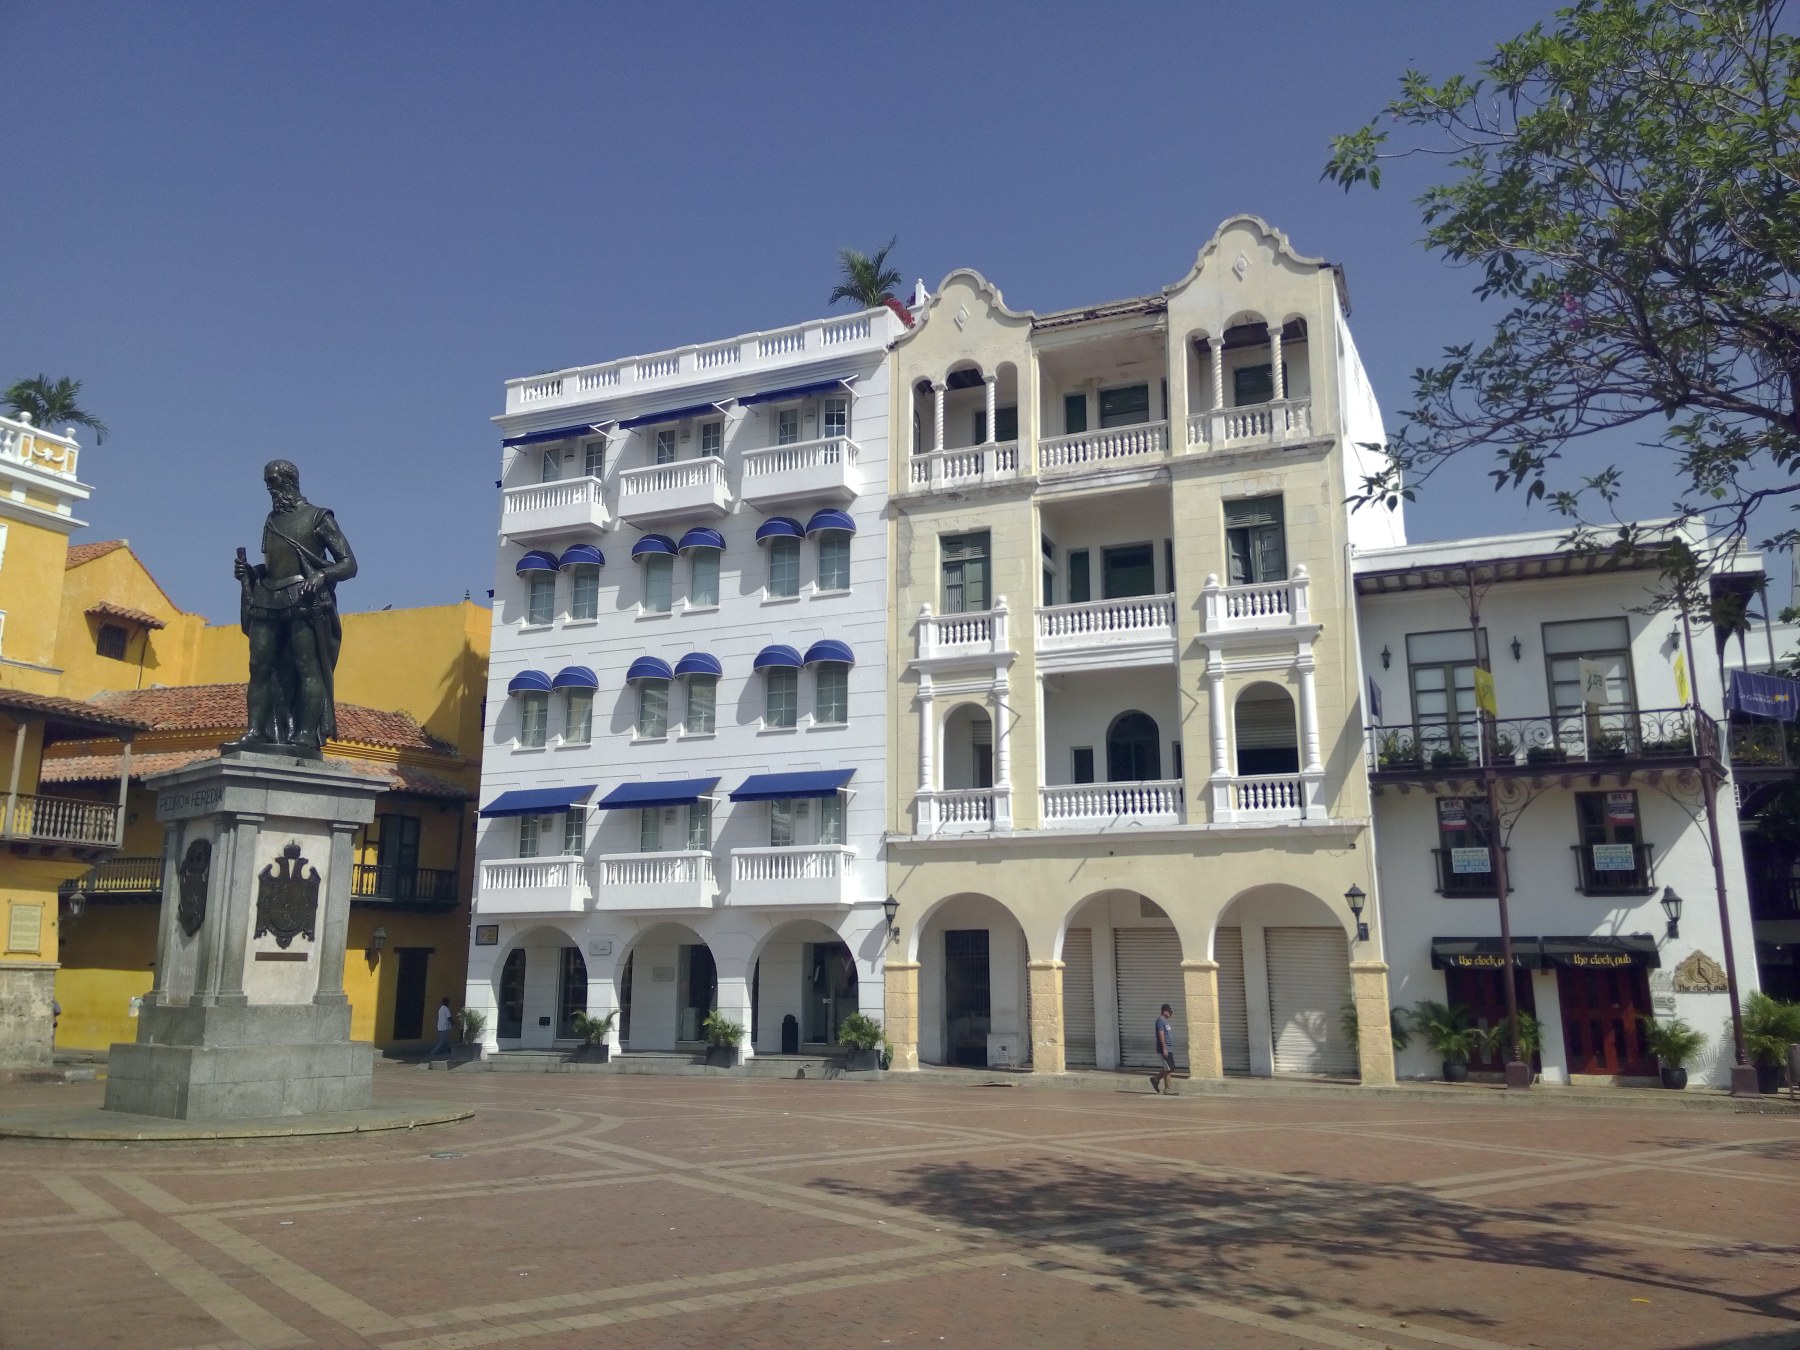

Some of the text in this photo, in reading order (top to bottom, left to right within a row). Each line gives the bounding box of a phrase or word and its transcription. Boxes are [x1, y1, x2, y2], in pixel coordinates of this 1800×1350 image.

[160, 794, 184, 812] PEDRO
[191, 787, 223, 808] HEREDIA
[1459, 955, 1473, 966] the
[1475, 955, 1498, 967] clock
[1574, 953, 1632, 966] the clock pub
[1693, 984, 1712, 992] clock
